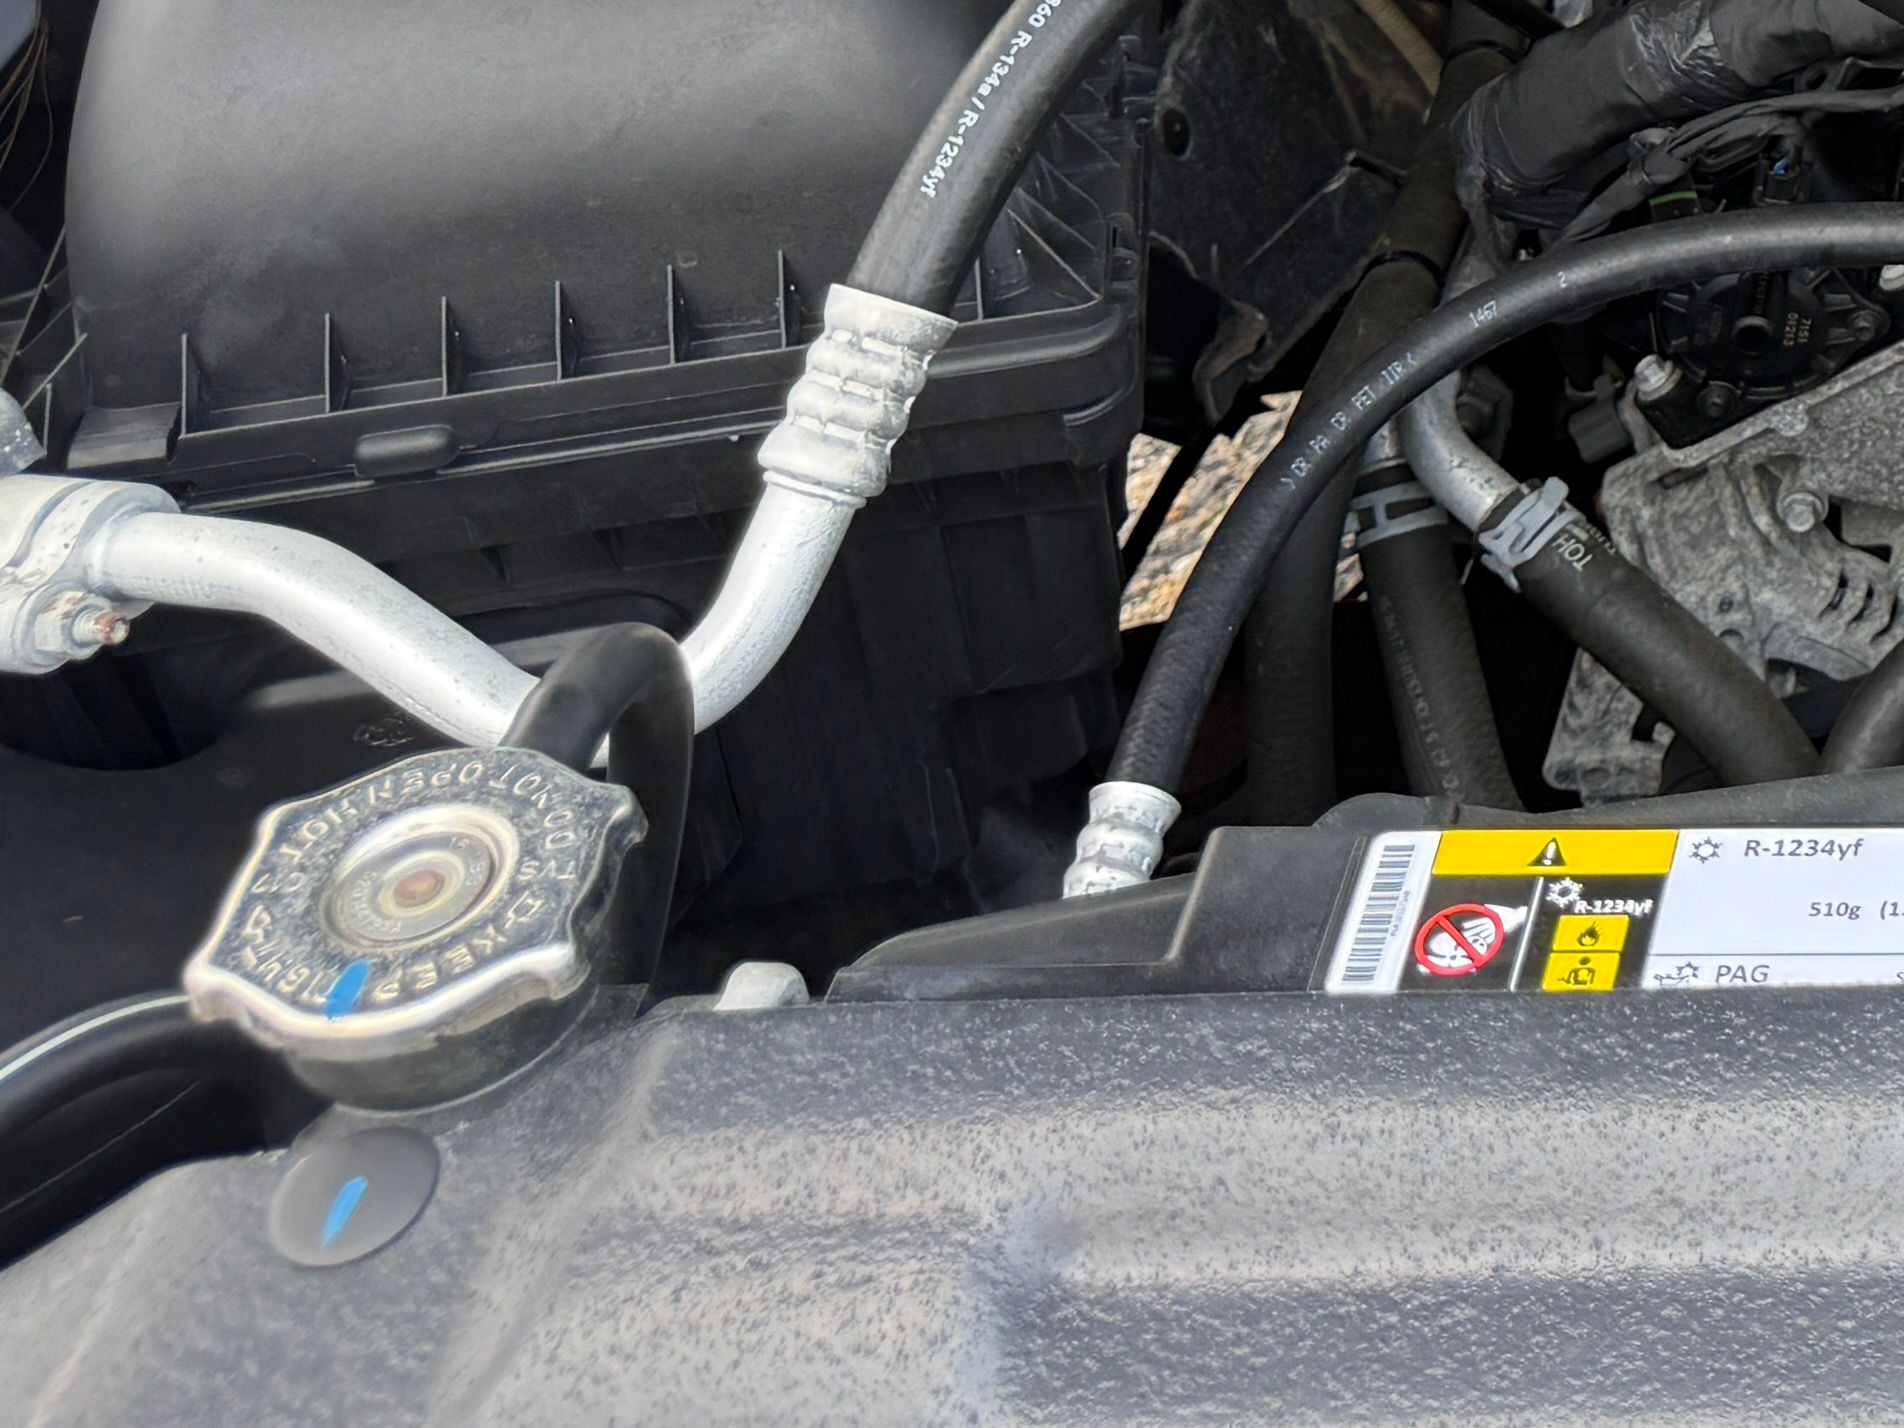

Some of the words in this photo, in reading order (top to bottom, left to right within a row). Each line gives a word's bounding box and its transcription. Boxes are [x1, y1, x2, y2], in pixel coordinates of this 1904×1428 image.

[977, 30, 1033, 96] R-134a
[920, 109, 980, 198] R-1234yf
[1559, 270, 1570, 289] 2
[1469, 300, 1497, 328] 1467
[1783, 312, 1798, 346] 01213
[1797, 318, 1811, 343] 7151
[1350, 384, 1378, 412] PET
[367, 760, 485, 807] OPEN
[1742, 837, 1863, 861] R-1234yf
[1574, 897, 1654, 917] R-1234yf
[1807, 899, 1862, 921] 510g
[1713, 964, 1769, 985] PAG
